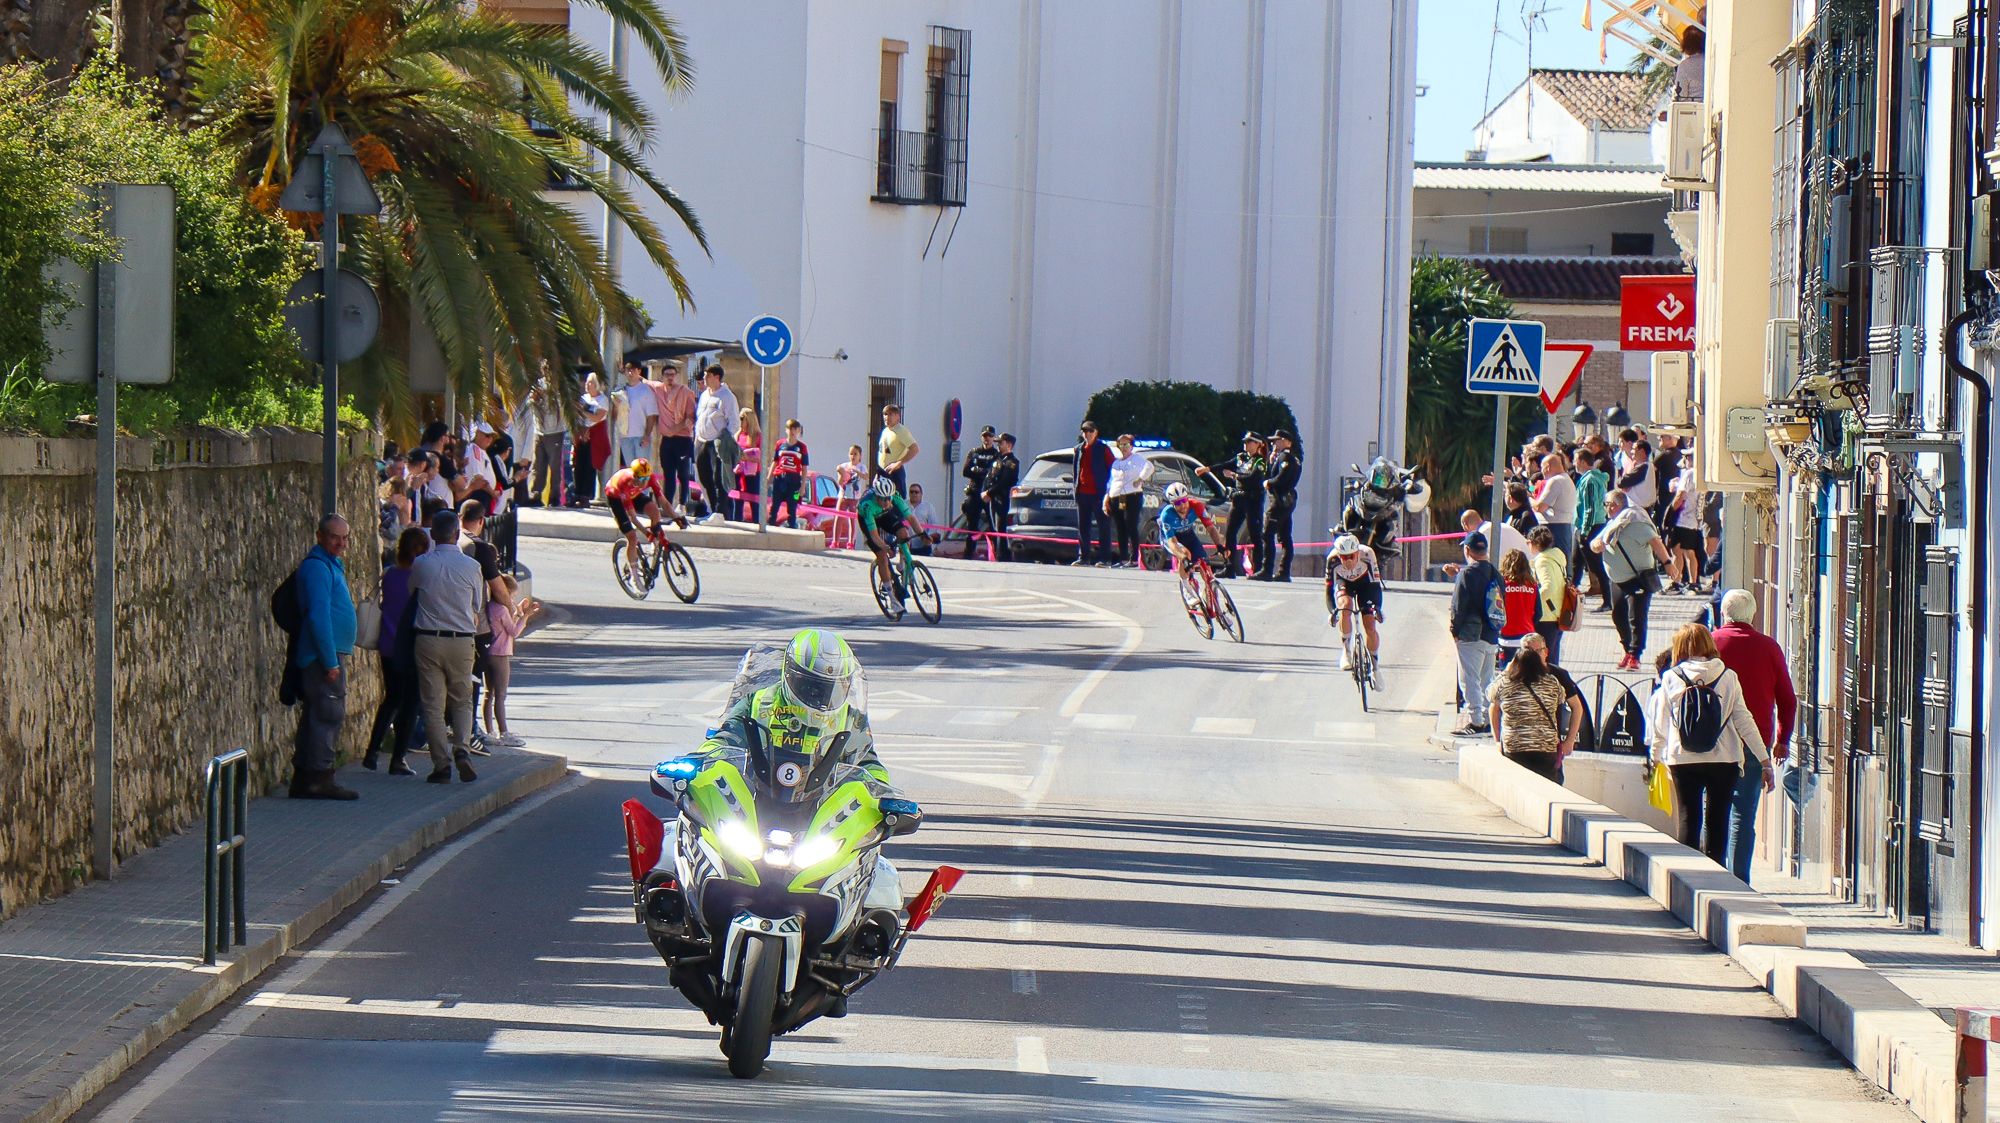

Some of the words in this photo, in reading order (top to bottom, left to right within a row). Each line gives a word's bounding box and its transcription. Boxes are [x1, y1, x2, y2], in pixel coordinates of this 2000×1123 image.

[1628, 326, 1696, 342] FREMA
[768, 733, 820, 749] TRÁFICO
[784, 767, 795, 781] 8
